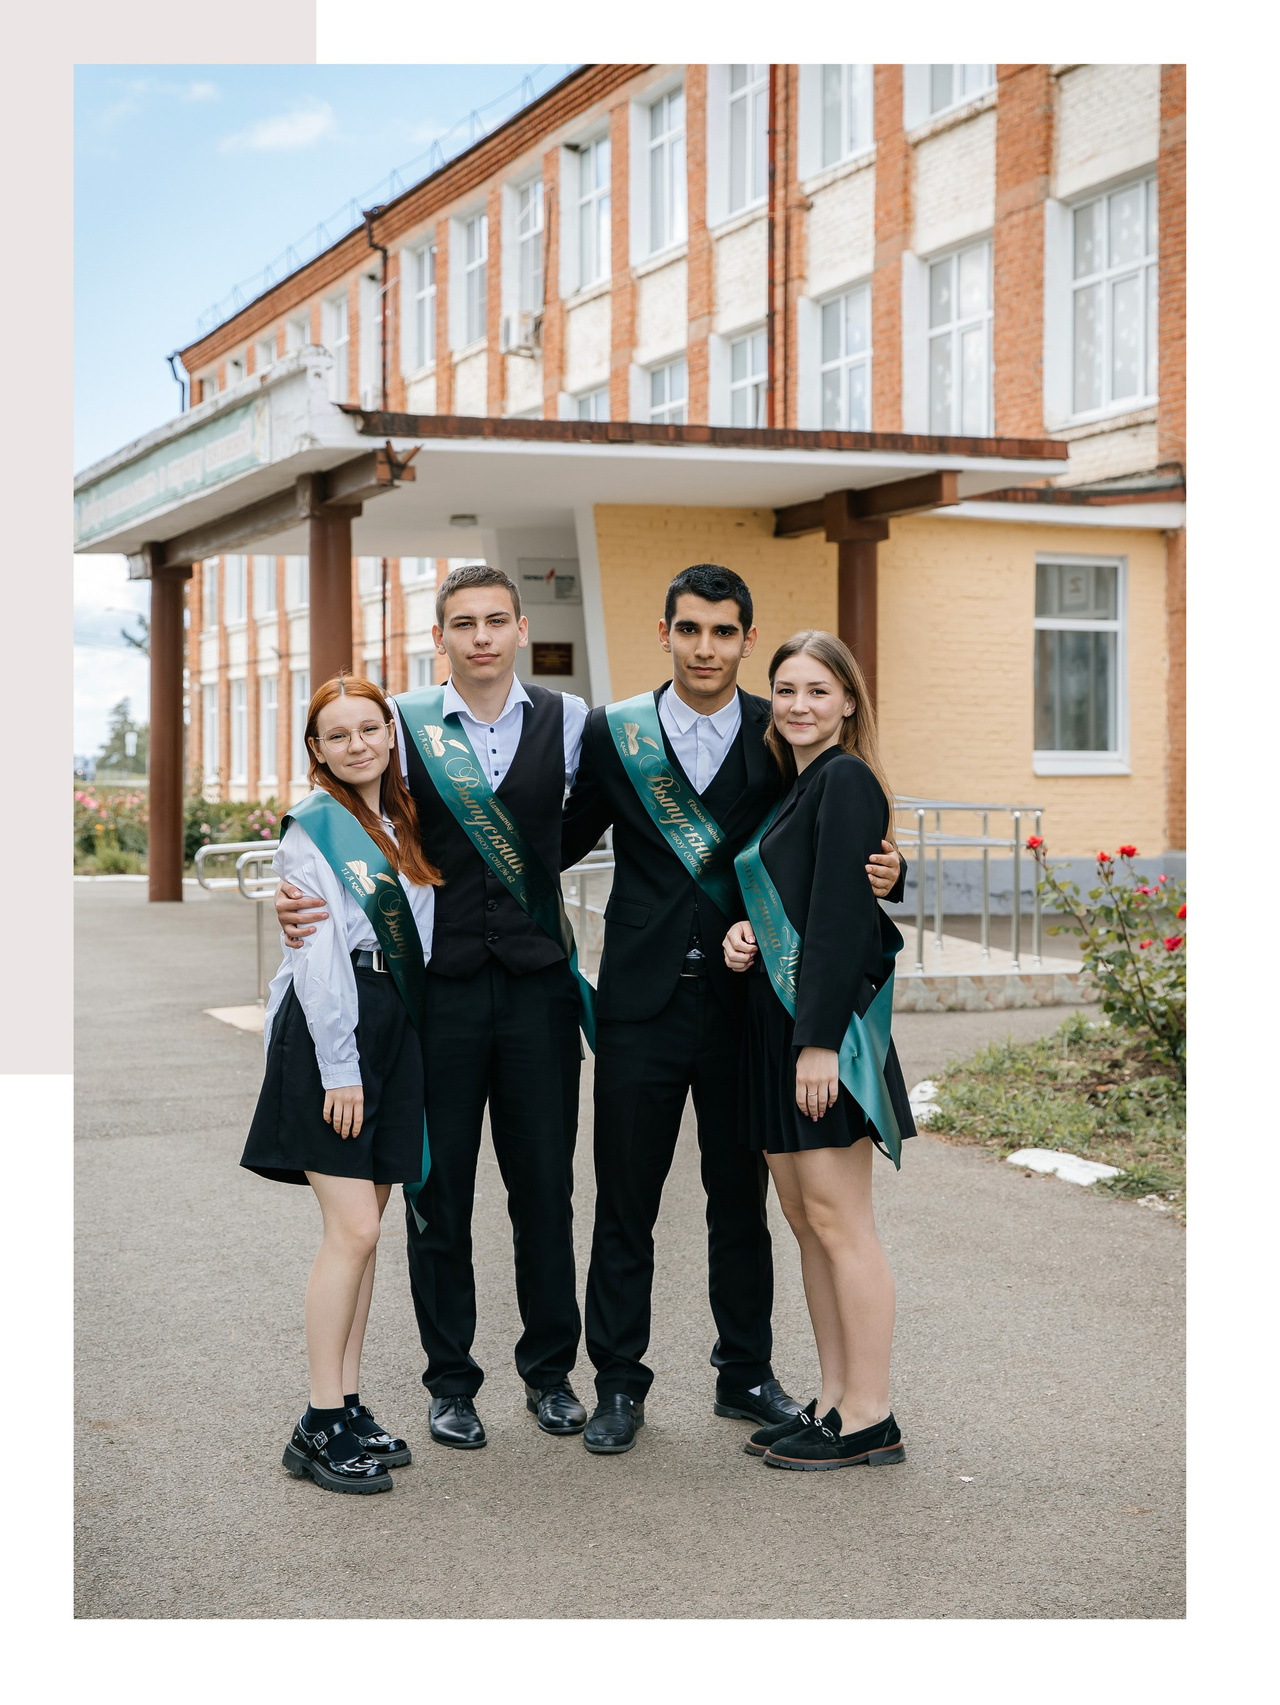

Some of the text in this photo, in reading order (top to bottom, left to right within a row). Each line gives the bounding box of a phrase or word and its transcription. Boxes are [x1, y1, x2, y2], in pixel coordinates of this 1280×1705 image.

[444, 758, 526, 876] Выпускник
[637, 756, 717, 868] Выпускни
[703, 821, 721, 844] Вадим
[340, 867, 349, 876] 11
[350, 881, 365, 898] класс
[505, 875, 515, 883] 62
